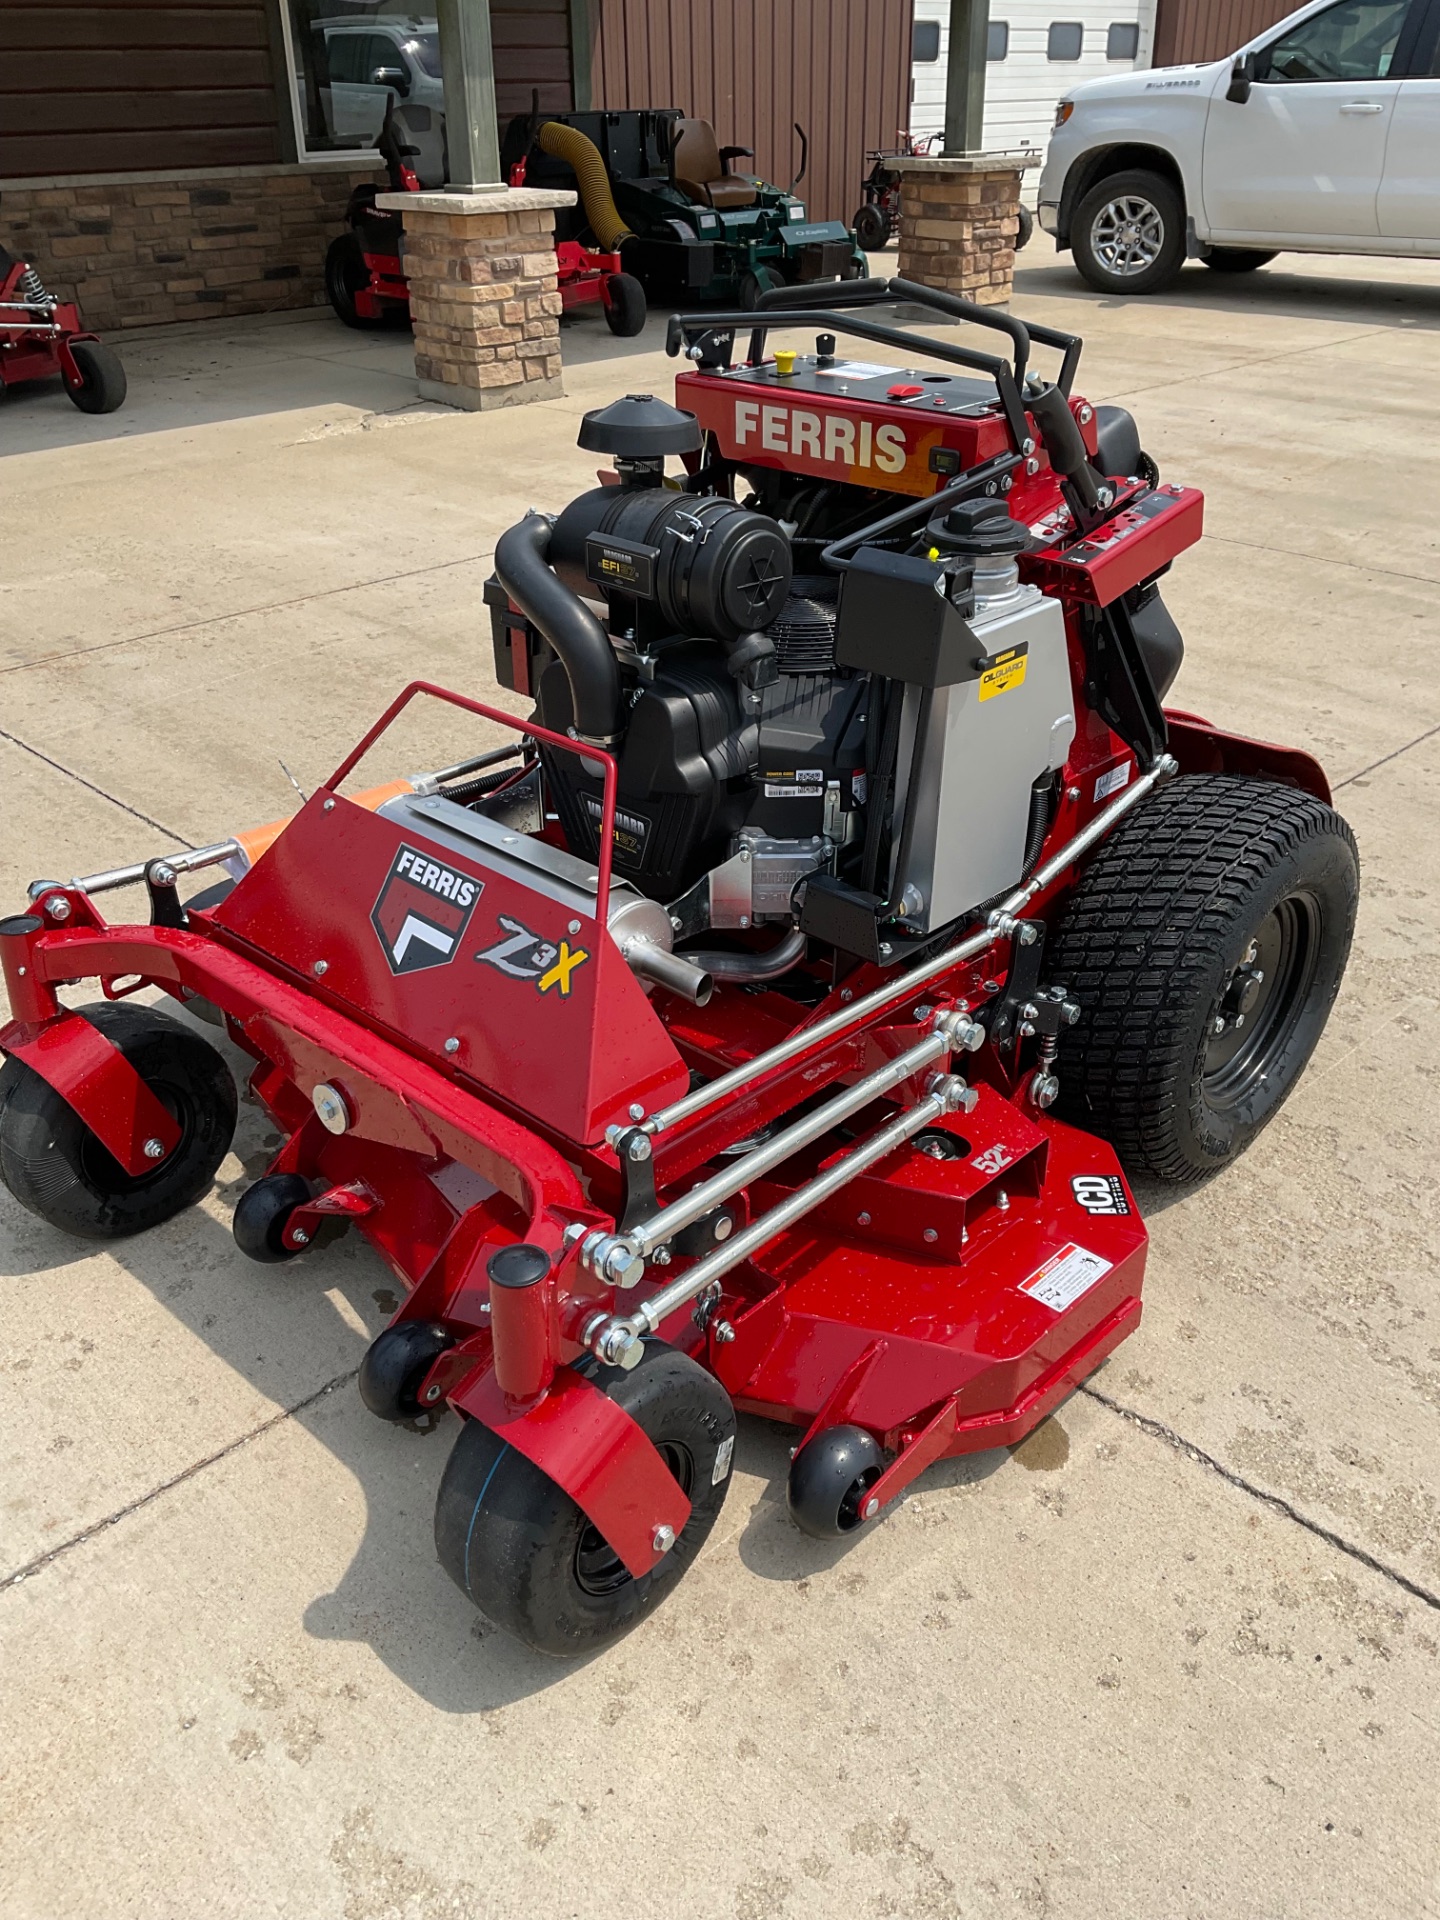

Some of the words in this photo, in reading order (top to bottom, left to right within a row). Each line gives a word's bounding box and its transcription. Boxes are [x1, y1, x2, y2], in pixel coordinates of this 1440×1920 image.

[1145, 80, 1201, 89] SILVERADO
[735, 400, 906, 473] FERRIS
[587, 800, 645, 836] VAUARD
[396, 850, 474, 906] FERRIS
[970, 1143, 1013, 1174] 52"
[1041, 1257, 1062, 1274] DANGER
